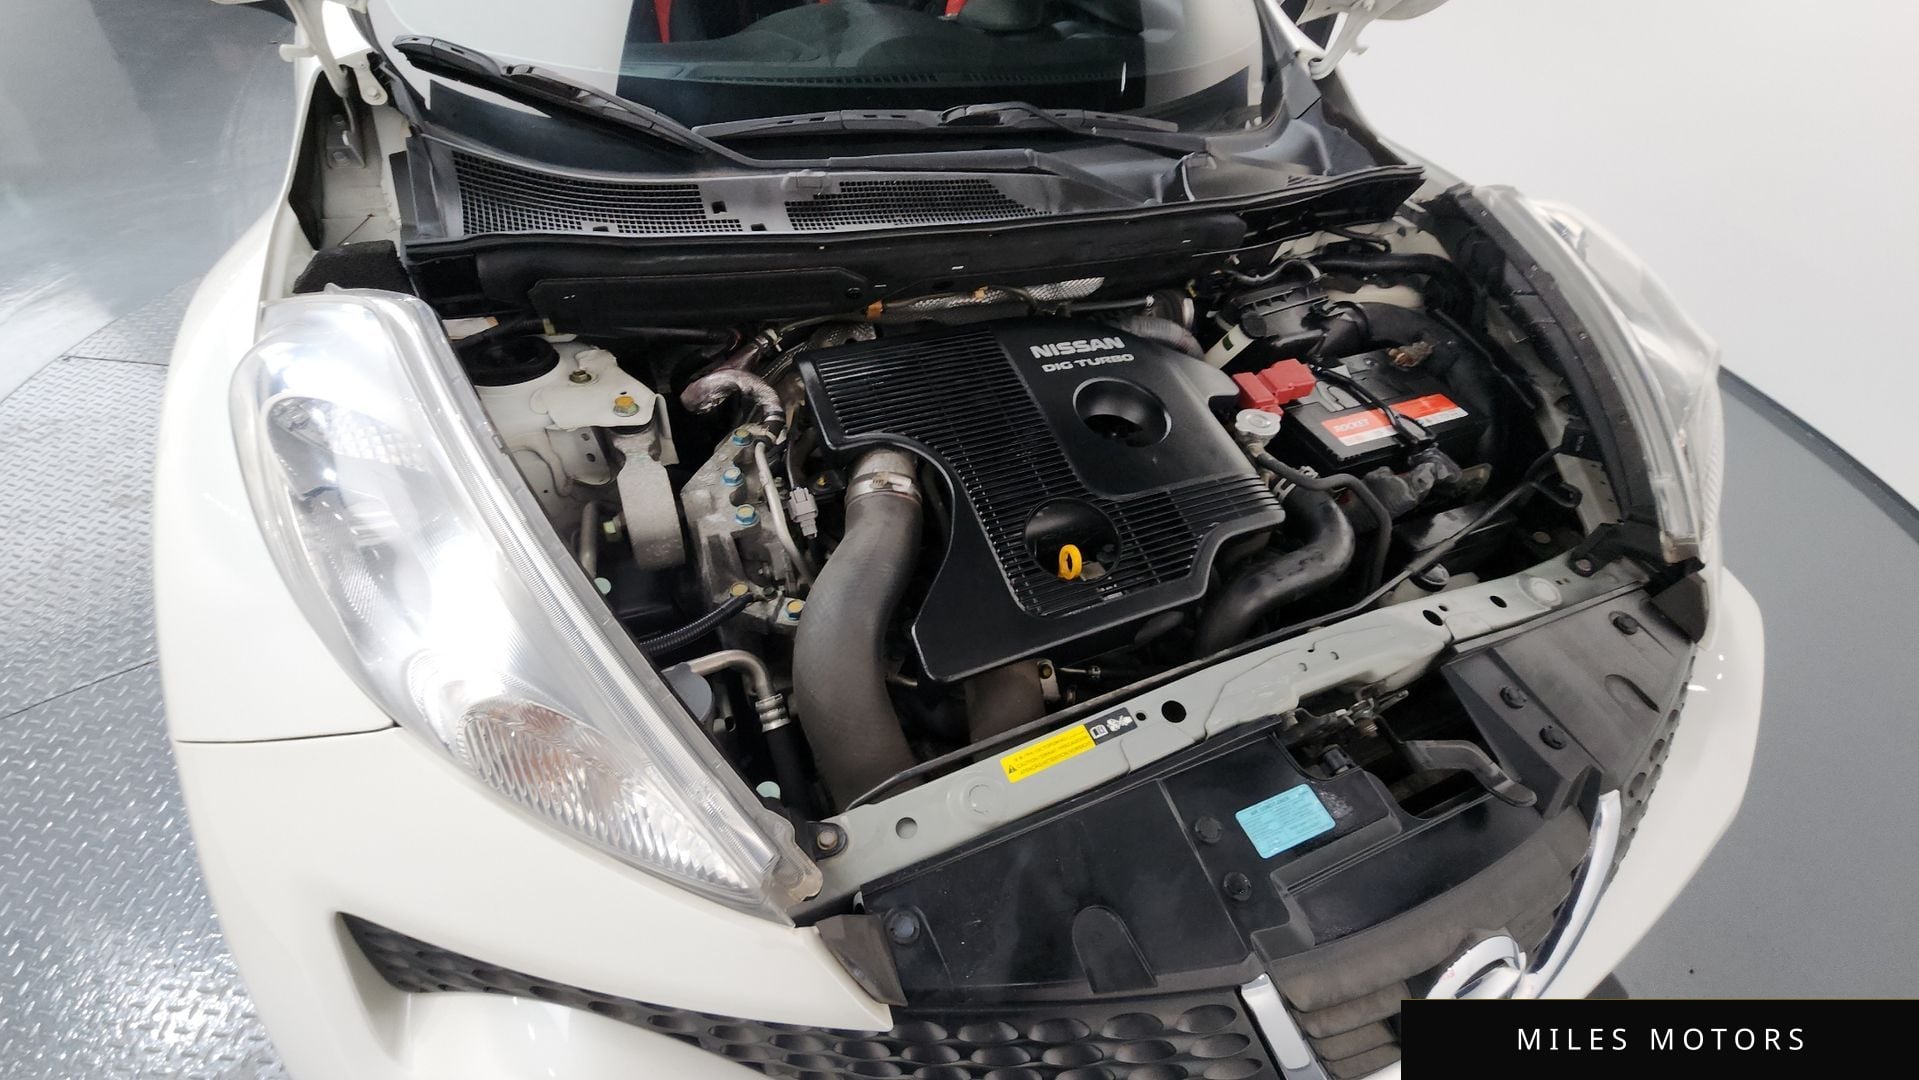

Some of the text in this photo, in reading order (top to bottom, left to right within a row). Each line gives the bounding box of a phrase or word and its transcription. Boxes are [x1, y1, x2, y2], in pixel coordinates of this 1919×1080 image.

[1029, 336, 1126, 359] NISSAN
[1041, 353, 1135, 373] DIG TURBO
